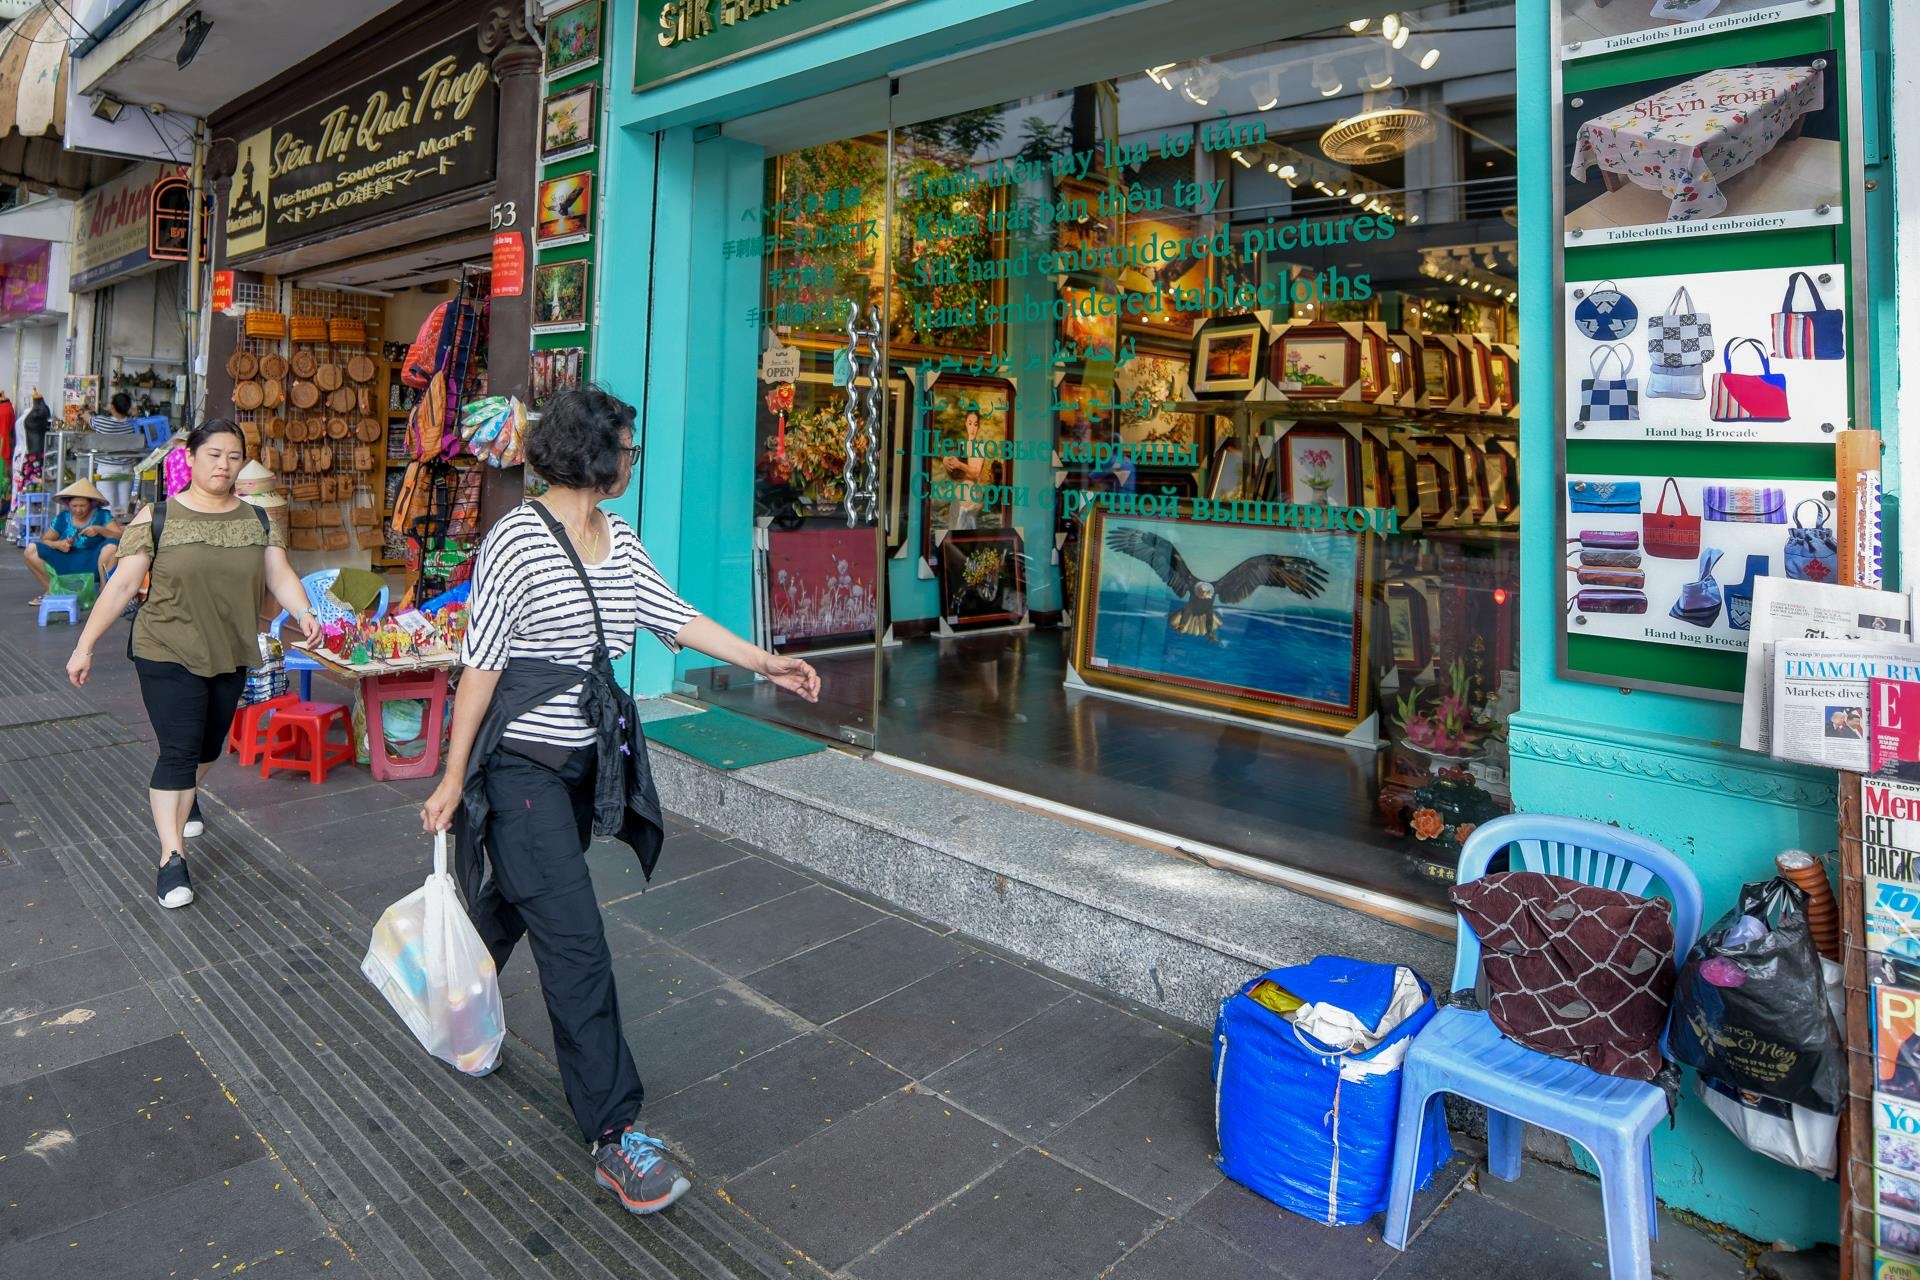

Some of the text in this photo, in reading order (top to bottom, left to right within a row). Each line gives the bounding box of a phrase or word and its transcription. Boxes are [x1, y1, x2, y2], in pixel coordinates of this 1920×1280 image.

[1604, 9, 1783, 50] Tablecloths Hand embroidery
[269, 55, 490, 179] Siêu Thị Quà Tặng
[273, 124, 477, 210] Vietnam Souvenir Mart
[911, 169, 980, 202] Tranh
[987, 155, 1043, 189] thêu
[1051, 148, 1094, 183] tay
[1103, 137, 1148, 173] lụa
[1038, 192, 1087, 228] bàn
[1098, 183, 1163, 219] thêu
[1174, 177, 1225, 213] tay
[1606, 215, 1787, 241] Tablecloths Hand embroidery
[912, 212, 1396, 289] Silk hand embroidered pictures
[912, 266, 1373, 331] Hand embroidered tablecloths
[766, 366, 795, 378] OPEN
[910, 428, 1200, 472] Шелковые картины
[1645, 427, 1759, 440] Hand bag Brocade
[909, 471, 1030, 513] Скатерти
[1038, 486, 1057, 510] с
[1061, 485, 1181, 522] ручной
[1644, 628, 1750, 649] Hand bag Brocad
[1785, 686, 1864, 699] Markets dive
[1865, 815, 1895, 847] GET
[1866, 844, 1913, 884] BACK
[1882, 992, 1920, 1037] P
